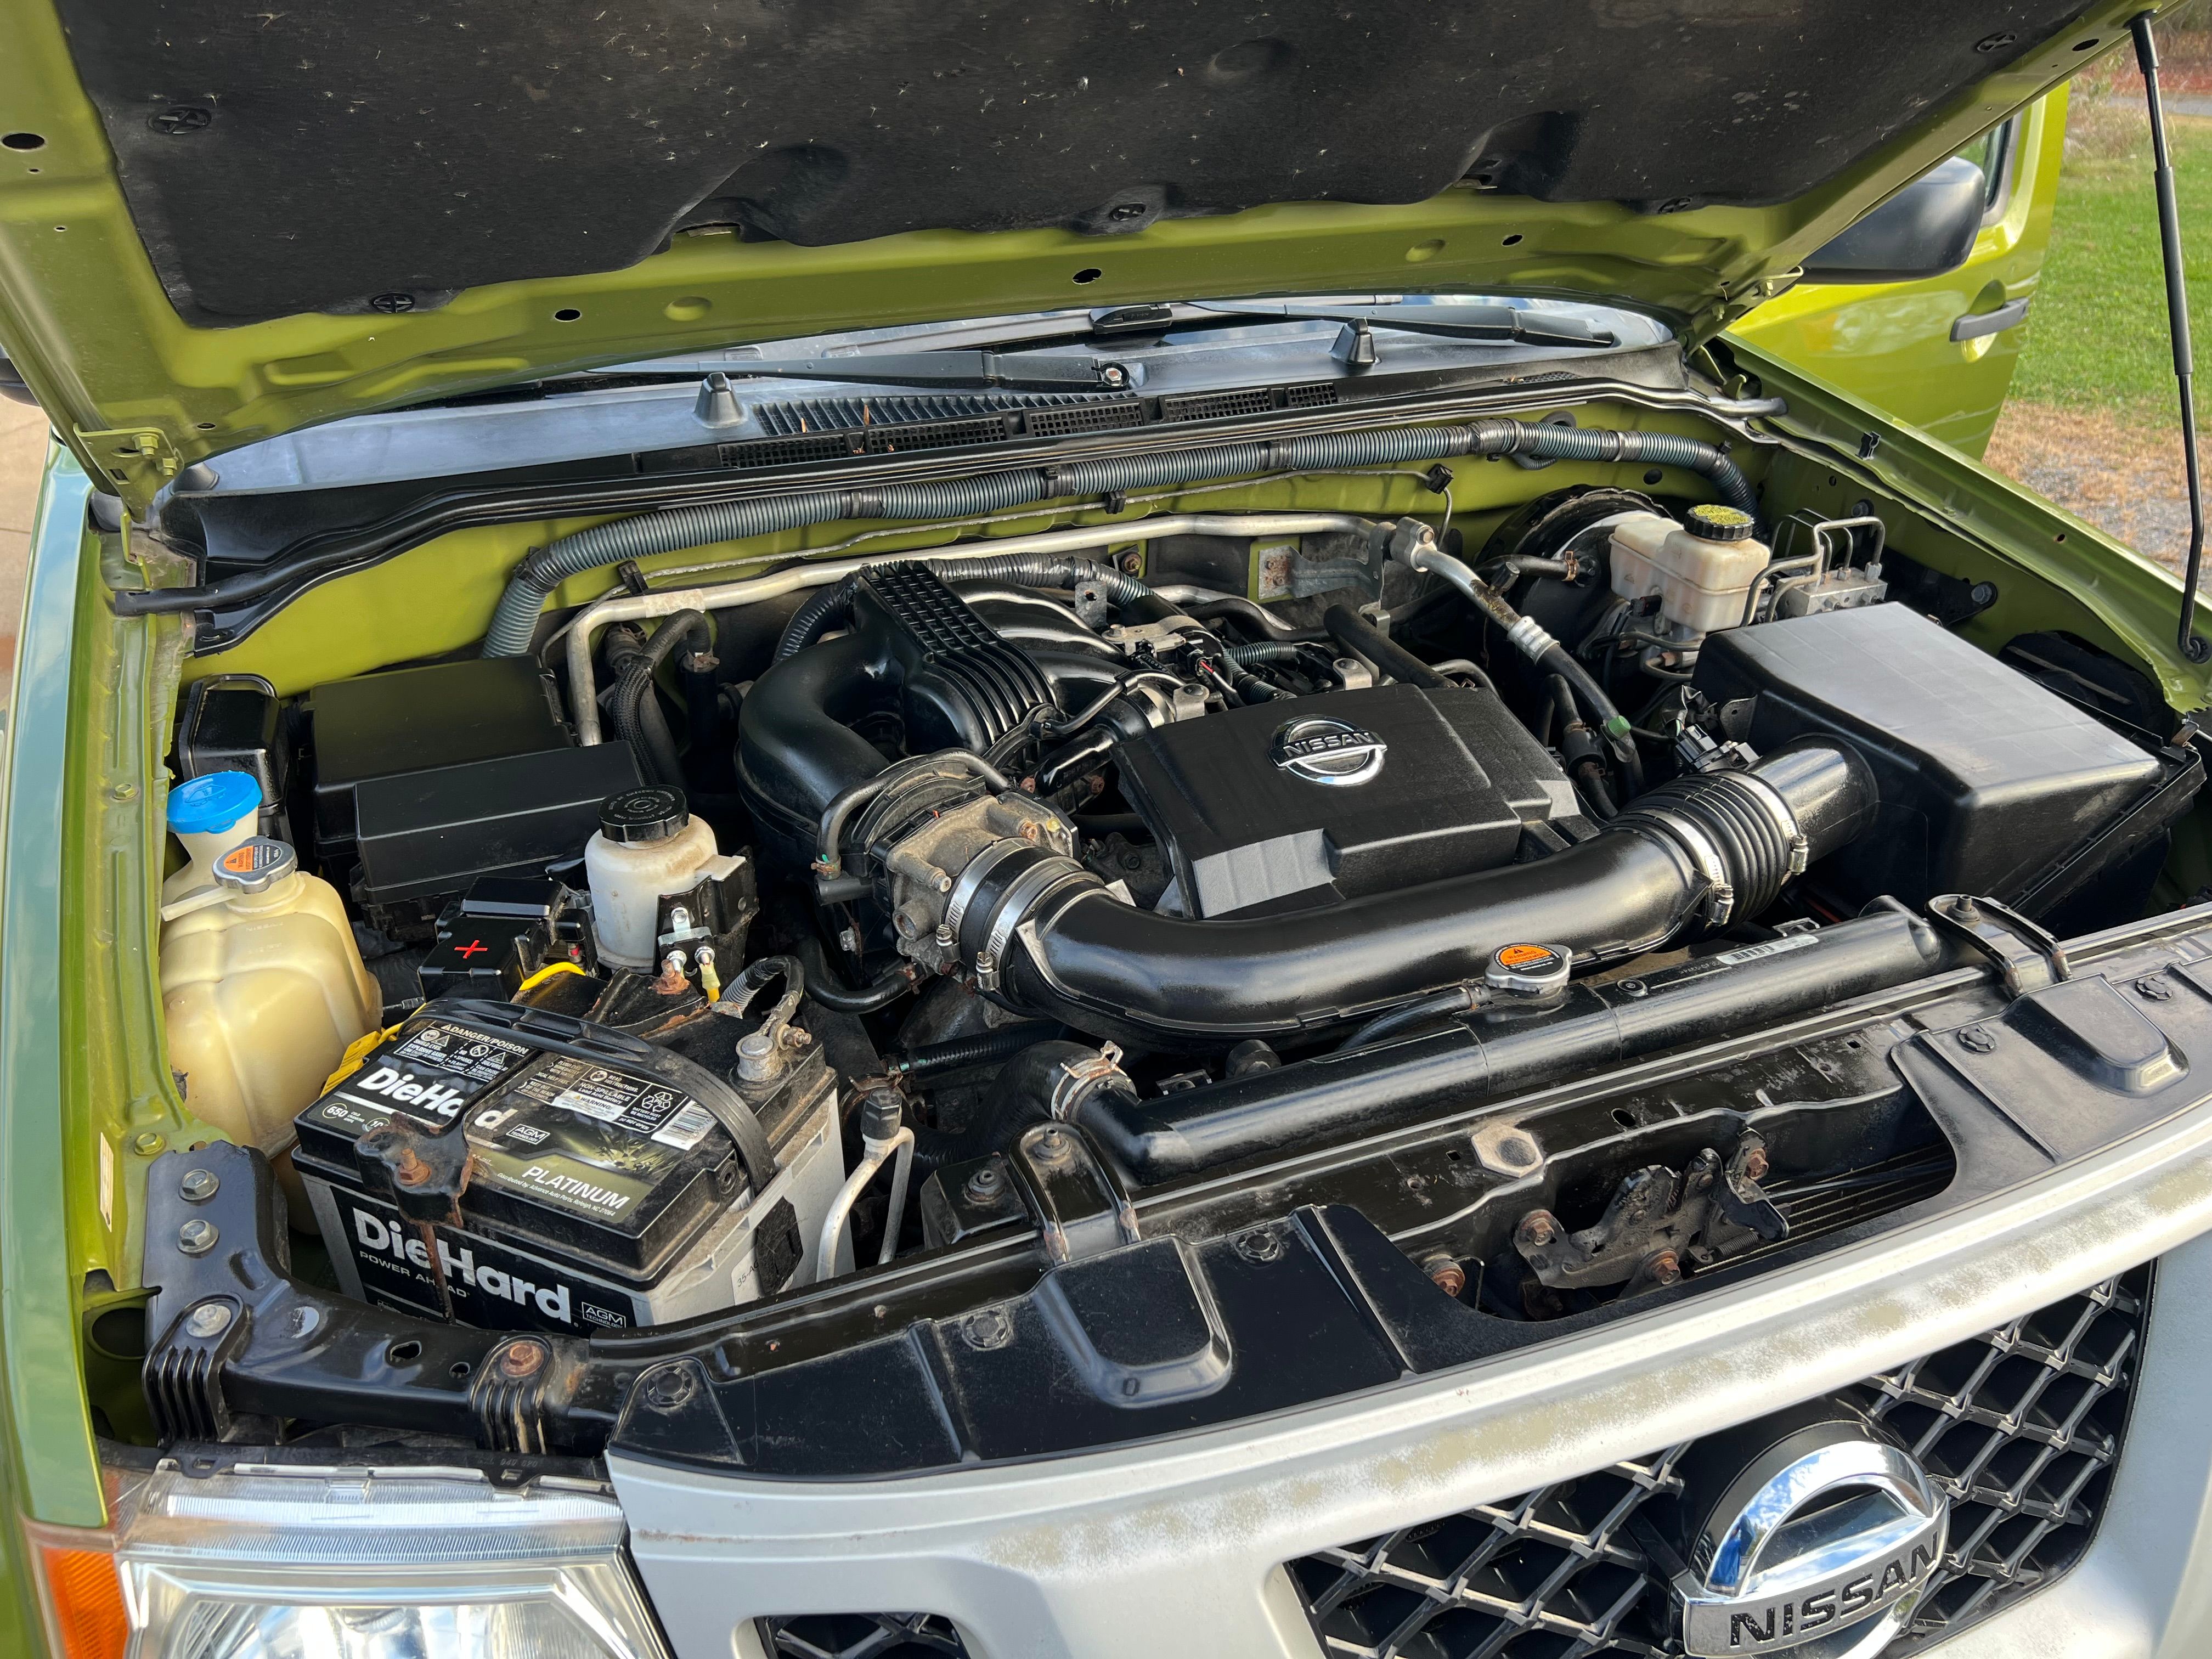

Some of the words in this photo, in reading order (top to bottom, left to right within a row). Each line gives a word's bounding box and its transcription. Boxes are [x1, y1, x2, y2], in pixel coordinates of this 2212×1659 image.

[1283, 732, 1375, 758] NISSAN
[451, 1026, 529, 1055] DANGER/POISON
[456, 1056, 473, 1064] SPARKS
[357, 1066, 518, 1130] DieHad
[578, 1087, 593, 1095] Lead
[591, 1090, 605, 1098] Acid
[603, 1094, 623, 1105] Battery
[580, 1082, 631, 1102] NON-SPILLABLE
[327, 1103, 348, 1118] 650
[633, 1107, 651, 1115] BATTERY
[636, 1112, 657, 1121] RECYCLED
[511, 1131, 539, 1143] TECHNOLOGY
[515, 1126, 546, 1140] AGM
[497, 1172, 523, 1186] Distributed
[529, 1184, 550, 1195] Advance
[548, 1190, 561, 1200] Auto
[598, 1206, 616, 1217] 27064
[522, 1166, 630, 1210] PLATINUM
[353, 1207, 572, 1324] DieHard
[360, 1250, 410, 1277] POWER
[415, 1273, 467, 1297] AHAD
[585, 1307, 623, 1325] AGM
[585, 1313, 623, 1328] TECHNOLOGY
[1730, 1531, 1939, 1647] NISSAN
